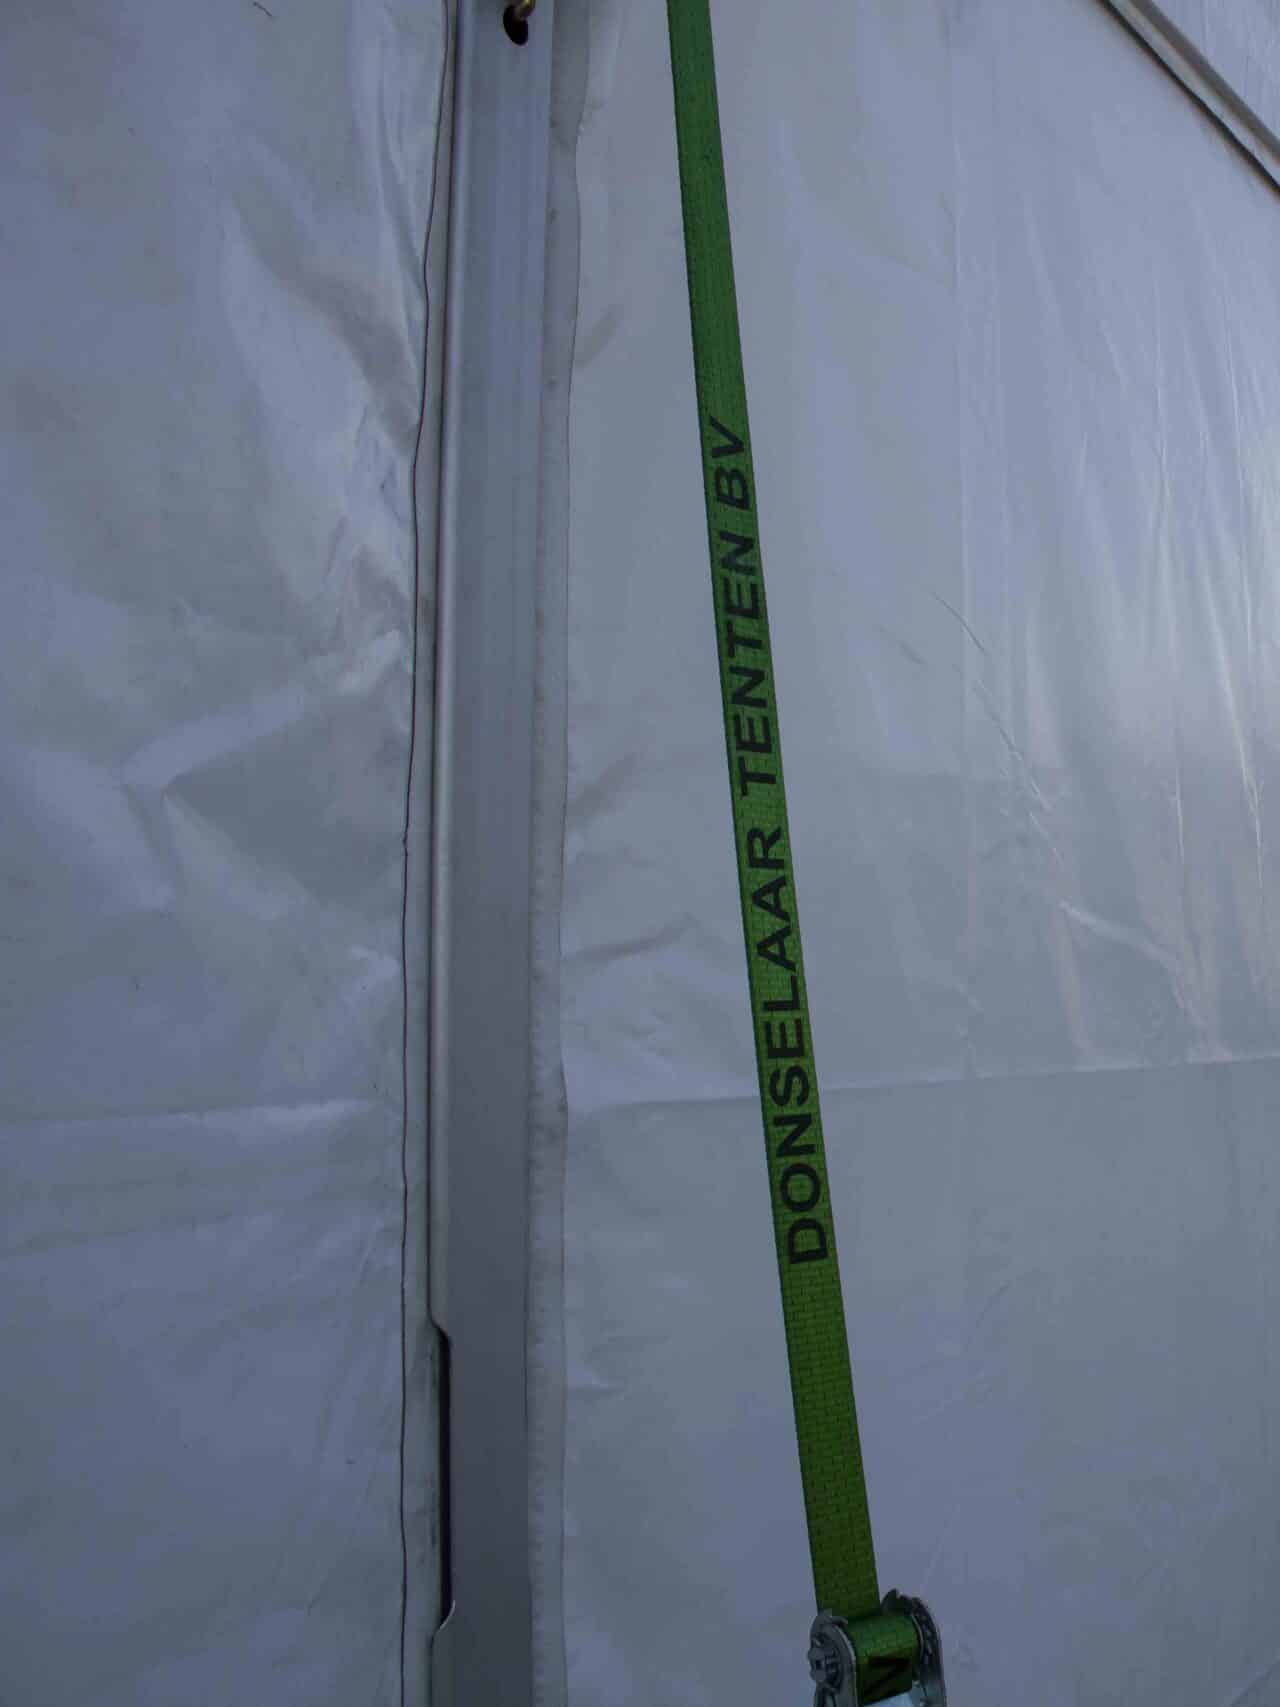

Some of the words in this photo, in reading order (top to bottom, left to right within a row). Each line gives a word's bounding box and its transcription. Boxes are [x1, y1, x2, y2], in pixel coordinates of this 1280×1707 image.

[710, 415, 750, 511] BV
[720, 531, 777, 797] TENTEN
[746, 826, 829, 1264] DONSELAAR
